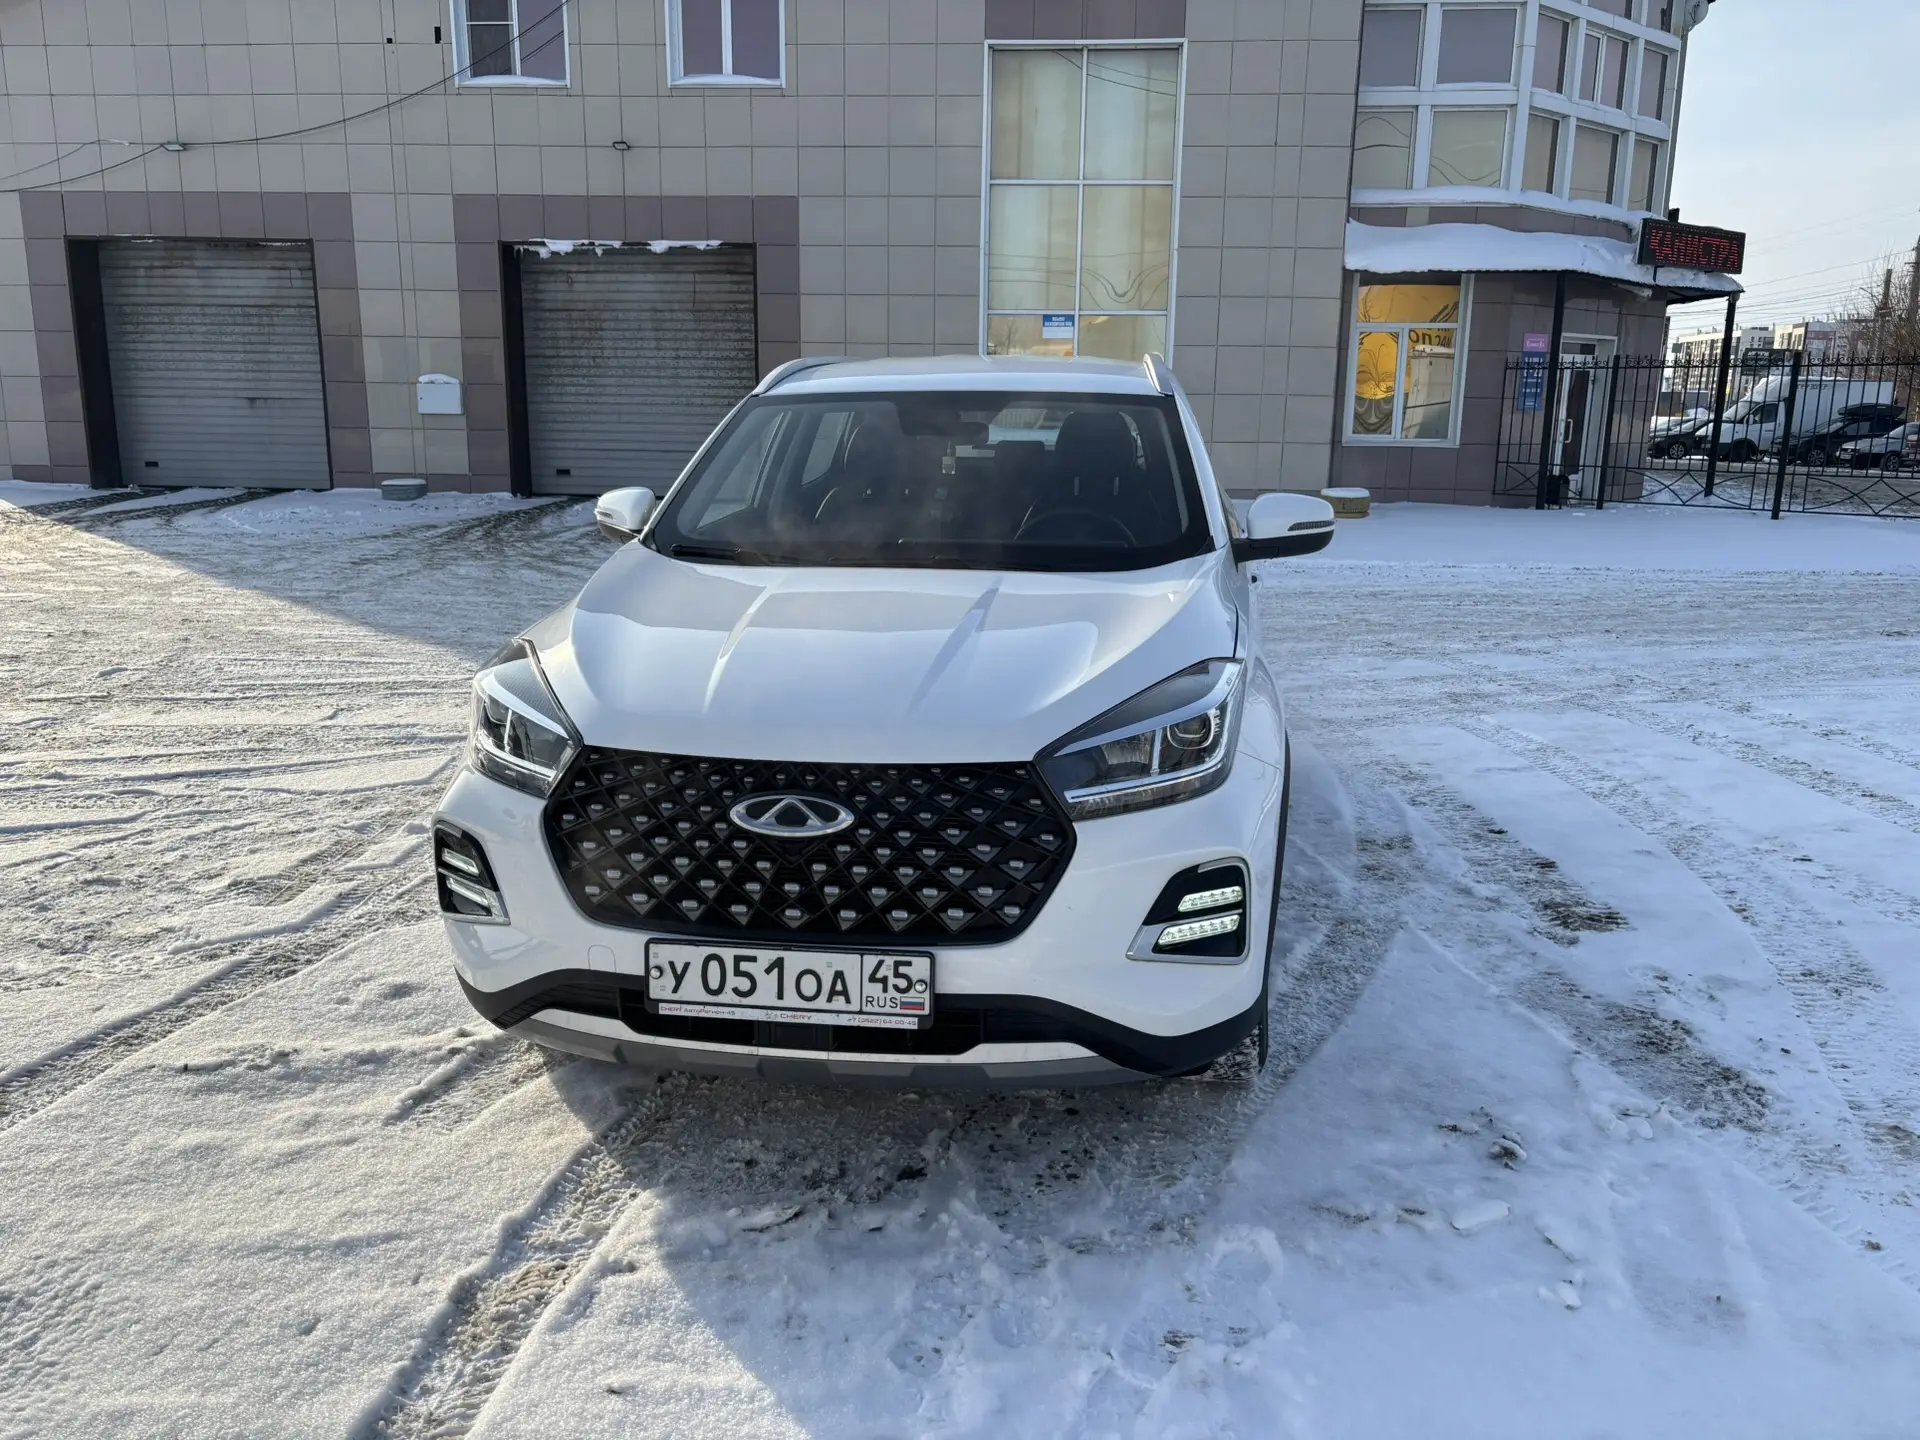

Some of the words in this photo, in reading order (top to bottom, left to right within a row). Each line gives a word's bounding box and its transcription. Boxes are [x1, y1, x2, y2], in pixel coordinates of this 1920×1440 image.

[868, 959, 914, 994] 45
[865, 996, 899, 1008] RUS
[780, 1012, 812, 1020] CHERY
